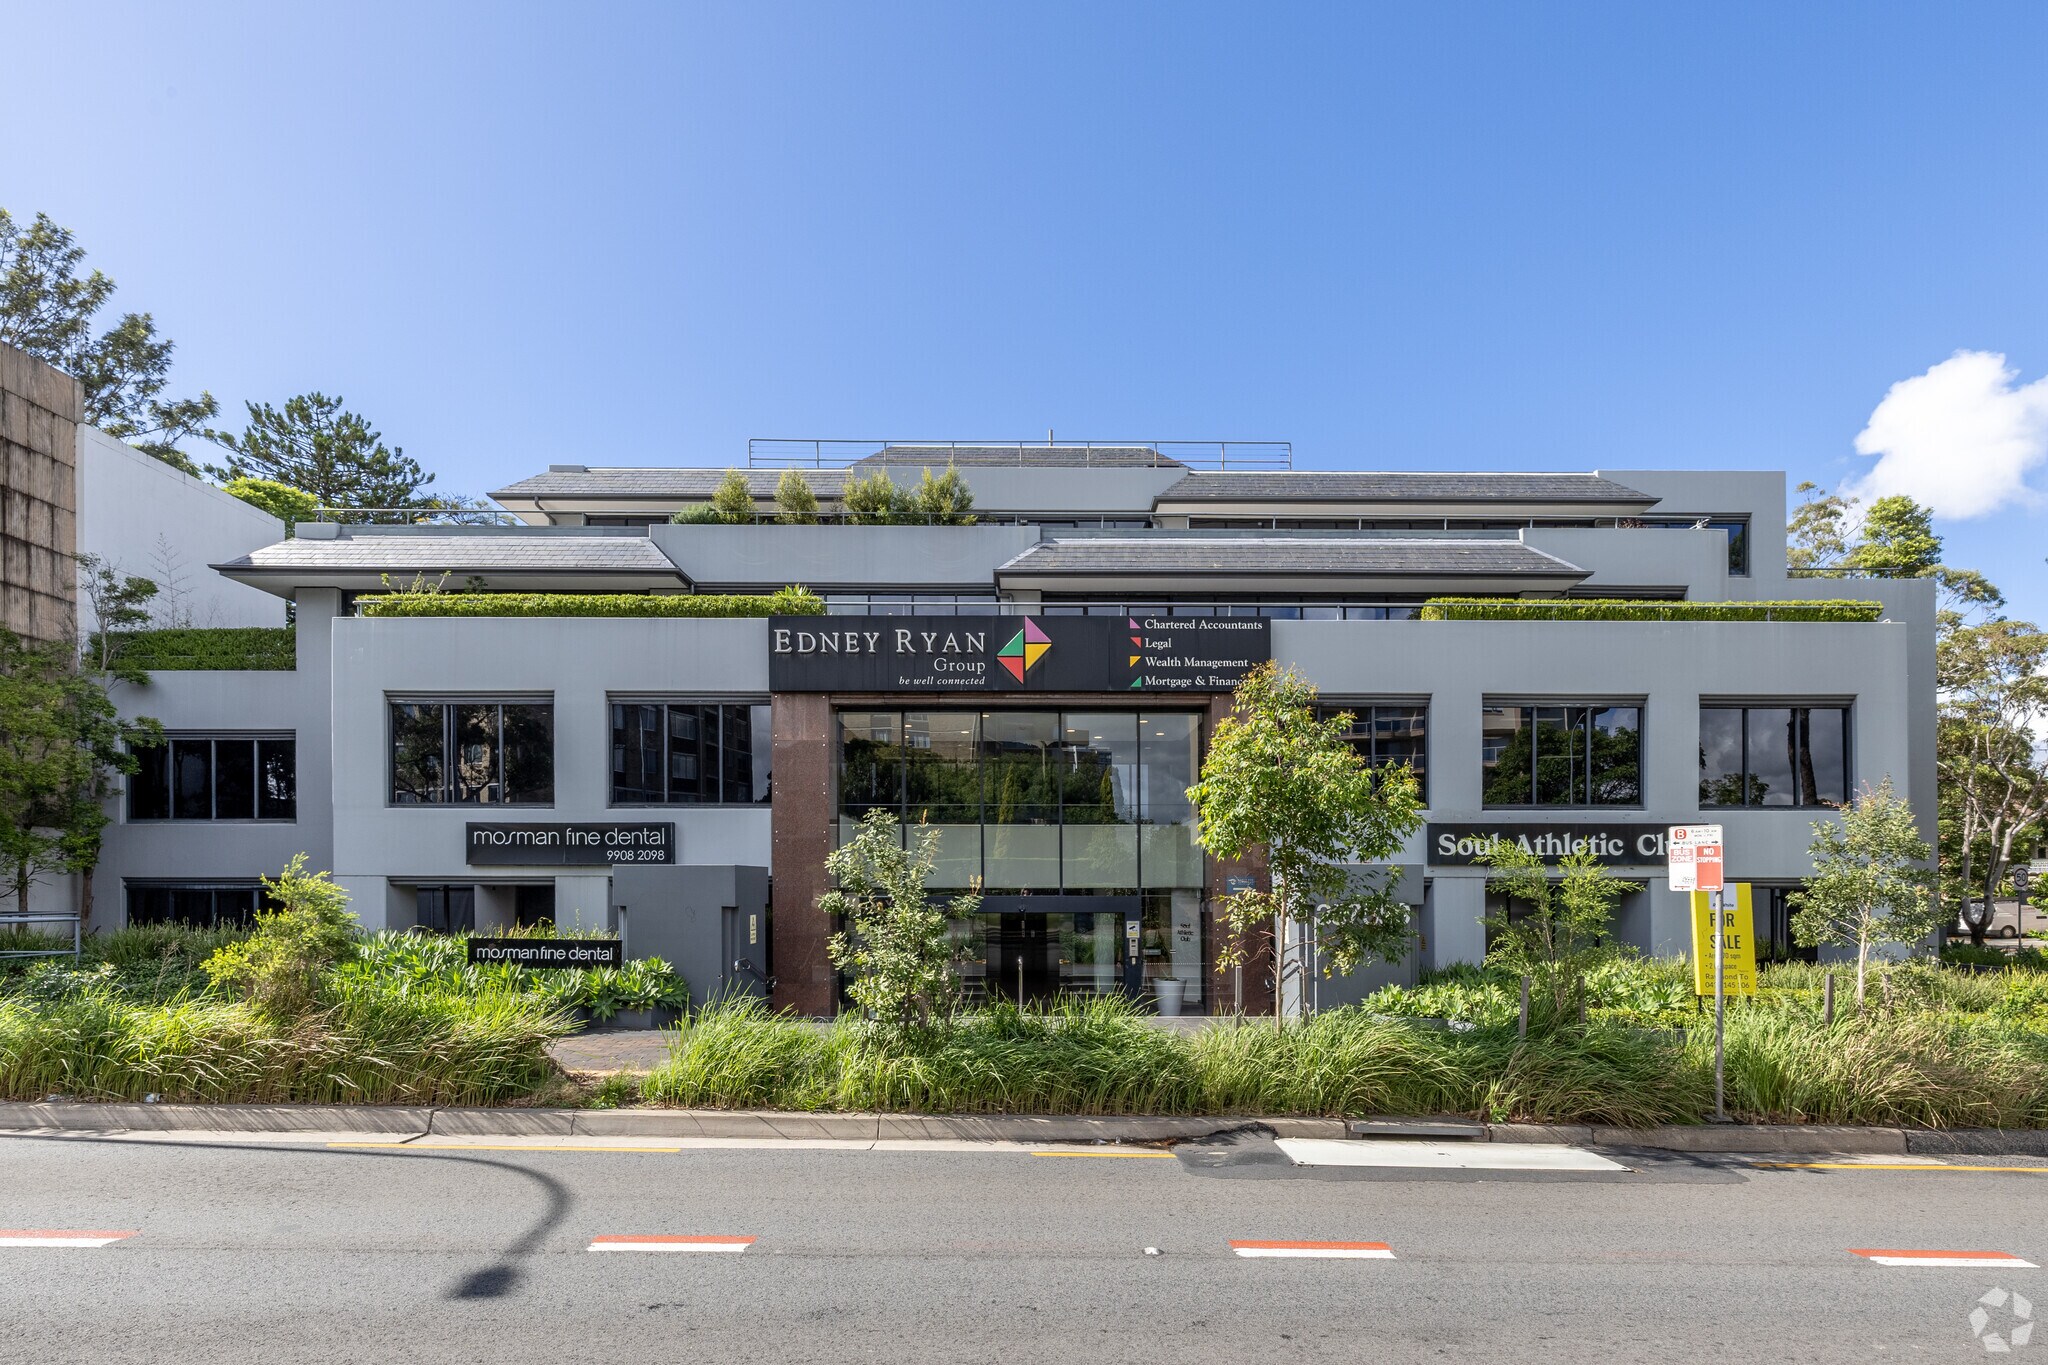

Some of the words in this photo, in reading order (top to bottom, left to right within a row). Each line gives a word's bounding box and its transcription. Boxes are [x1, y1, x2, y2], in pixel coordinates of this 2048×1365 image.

[1145, 619, 1196, 629] Chartered
[1199, 619, 1263, 629] Accountants
[774, 629, 880, 653] EDNEY
[895, 629, 985, 653] RYAN
[1145, 638, 1172, 650] Legal
[934, 658, 986, 674] Group
[1145, 656, 1182, 667] Wealth
[1184, 657, 1249, 669] Management
[899, 676, 910, 685] be
[913, 676, 934, 685] well
[937, 676, 985, 685] connected
[1145, 676, 1192, 688] Mortgage
[1195, 676, 1206, 686] &
[473, 830, 560, 845] mosman
[565, 828, 600, 845] fine
[605, 828, 665, 845] dental
[1516, 832, 1624, 856] Athletic
[1636, 832, 1669, 856] Cl
[606, 850, 635, 861] 9908
[637, 850, 665, 861] 2098
[2016, 873, 2026, 881] 50
[476, 947, 539, 959] mosman
[540, 946, 566, 959] fine
[568, 946, 613, 960] dental
